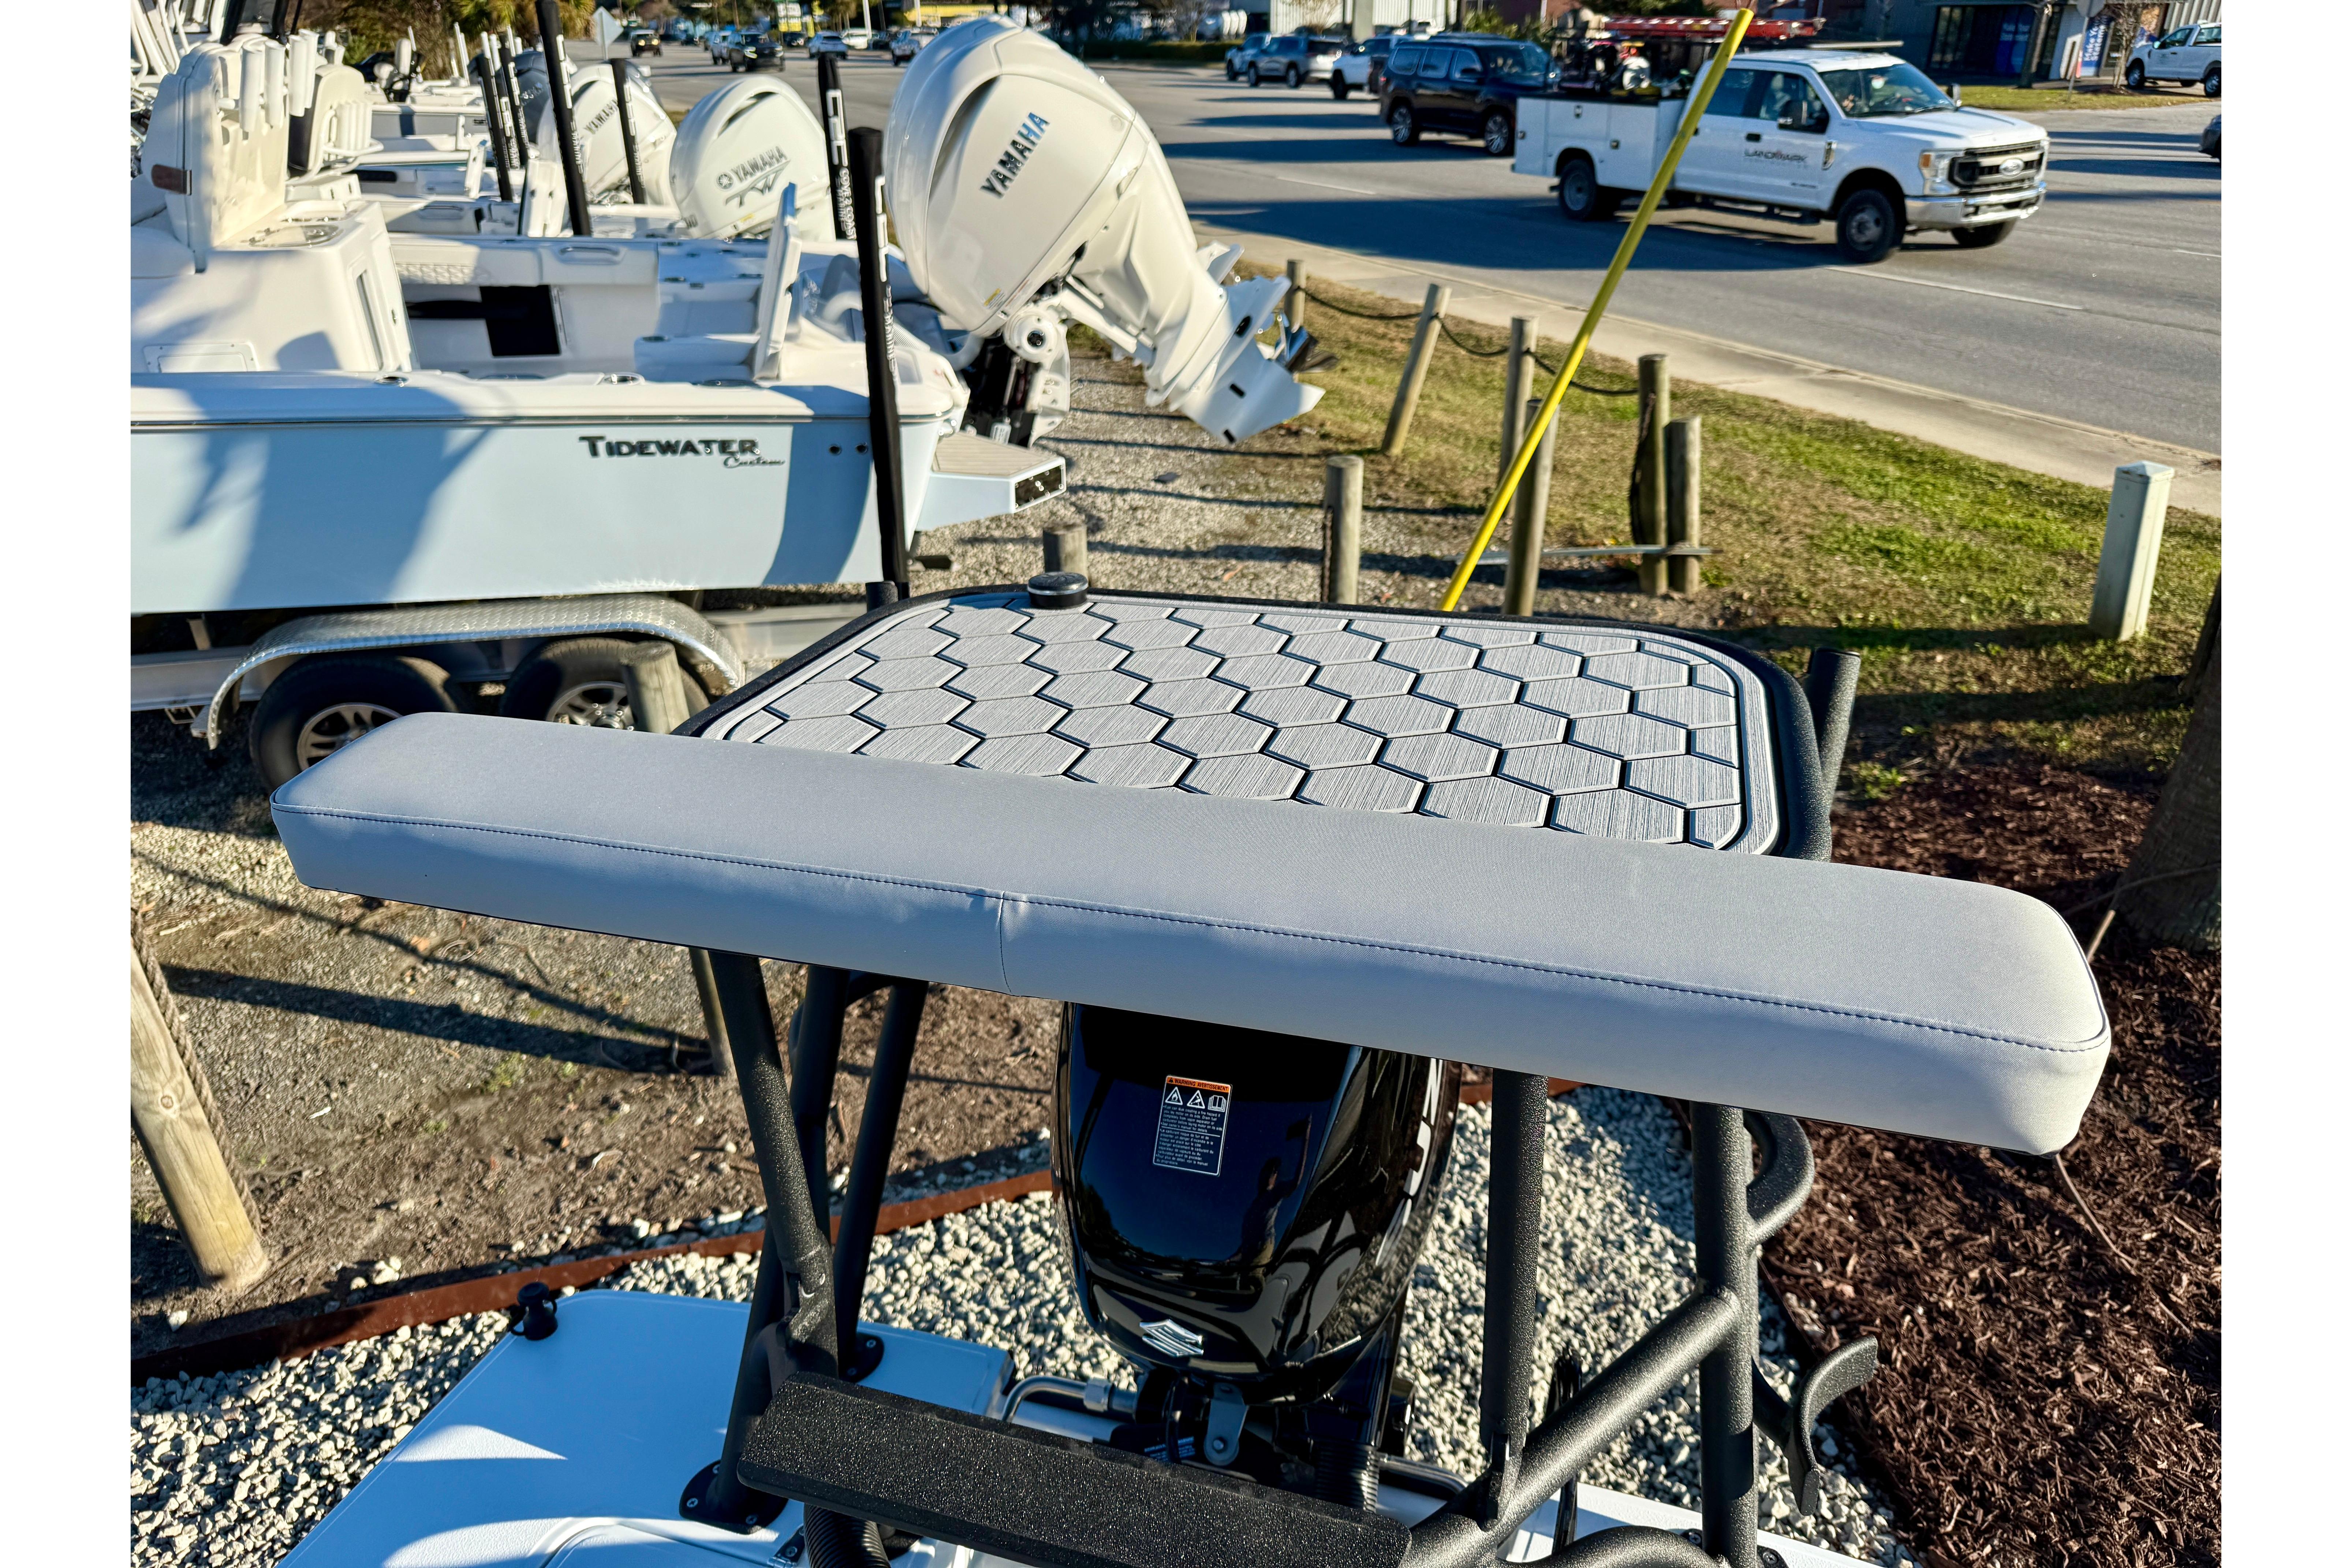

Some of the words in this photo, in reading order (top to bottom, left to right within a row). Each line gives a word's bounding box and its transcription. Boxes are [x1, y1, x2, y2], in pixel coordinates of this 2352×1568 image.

[731, 146, 788, 183] YAMAHA
[979, 112, 1050, 199] YAMAHA
[578, 436, 760, 457] TIDEWATER
[723, 456, 786, 468] Custom
[1175, 1078, 1196, 1086] WARNING
[1197, 1082, 1228, 1091] AVERTISSEMENT
